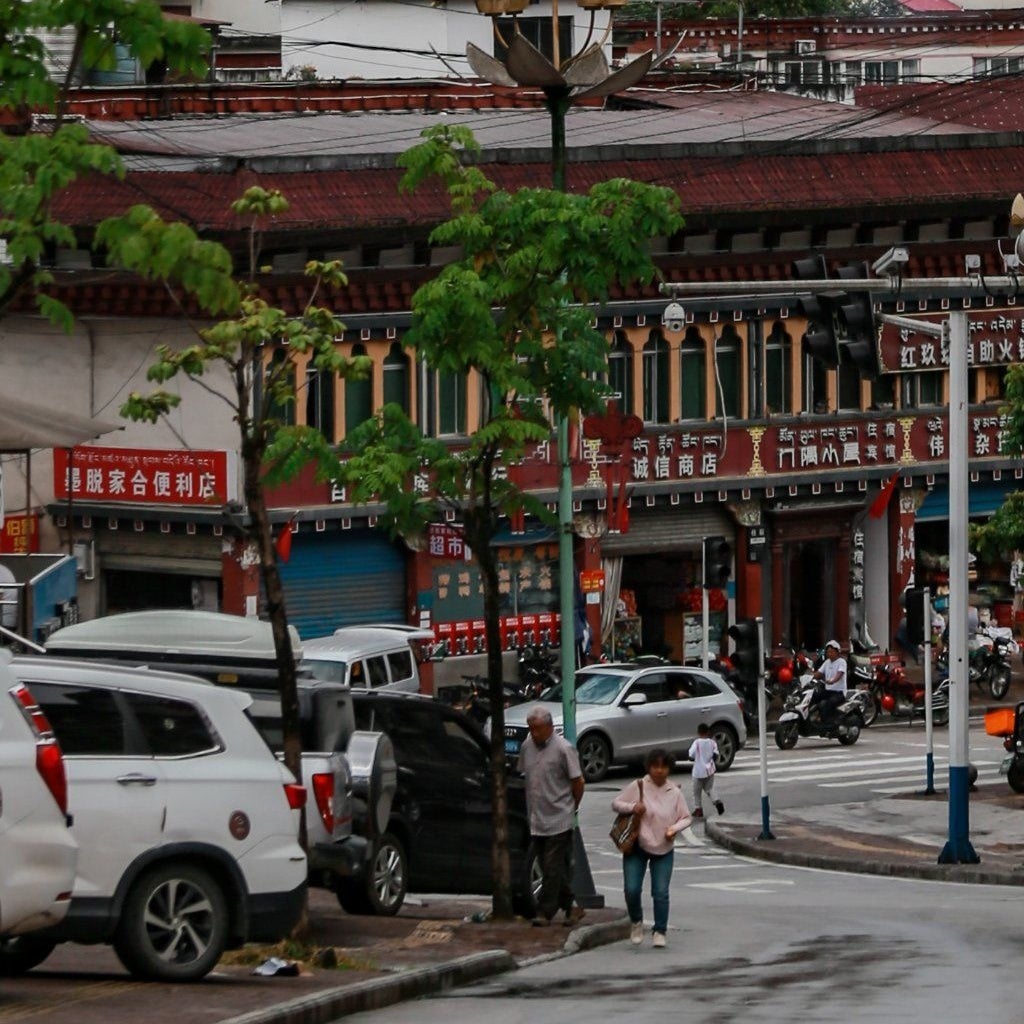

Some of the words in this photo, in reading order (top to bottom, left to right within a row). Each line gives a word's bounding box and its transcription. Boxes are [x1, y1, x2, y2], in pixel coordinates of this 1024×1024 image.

[866, 422, 896, 438] 住宿
[866, 444, 896, 460] 宾馆
[632, 452, 717, 479] 诚信商店
[64, 467, 216, 498] 墨脱家合便利店
